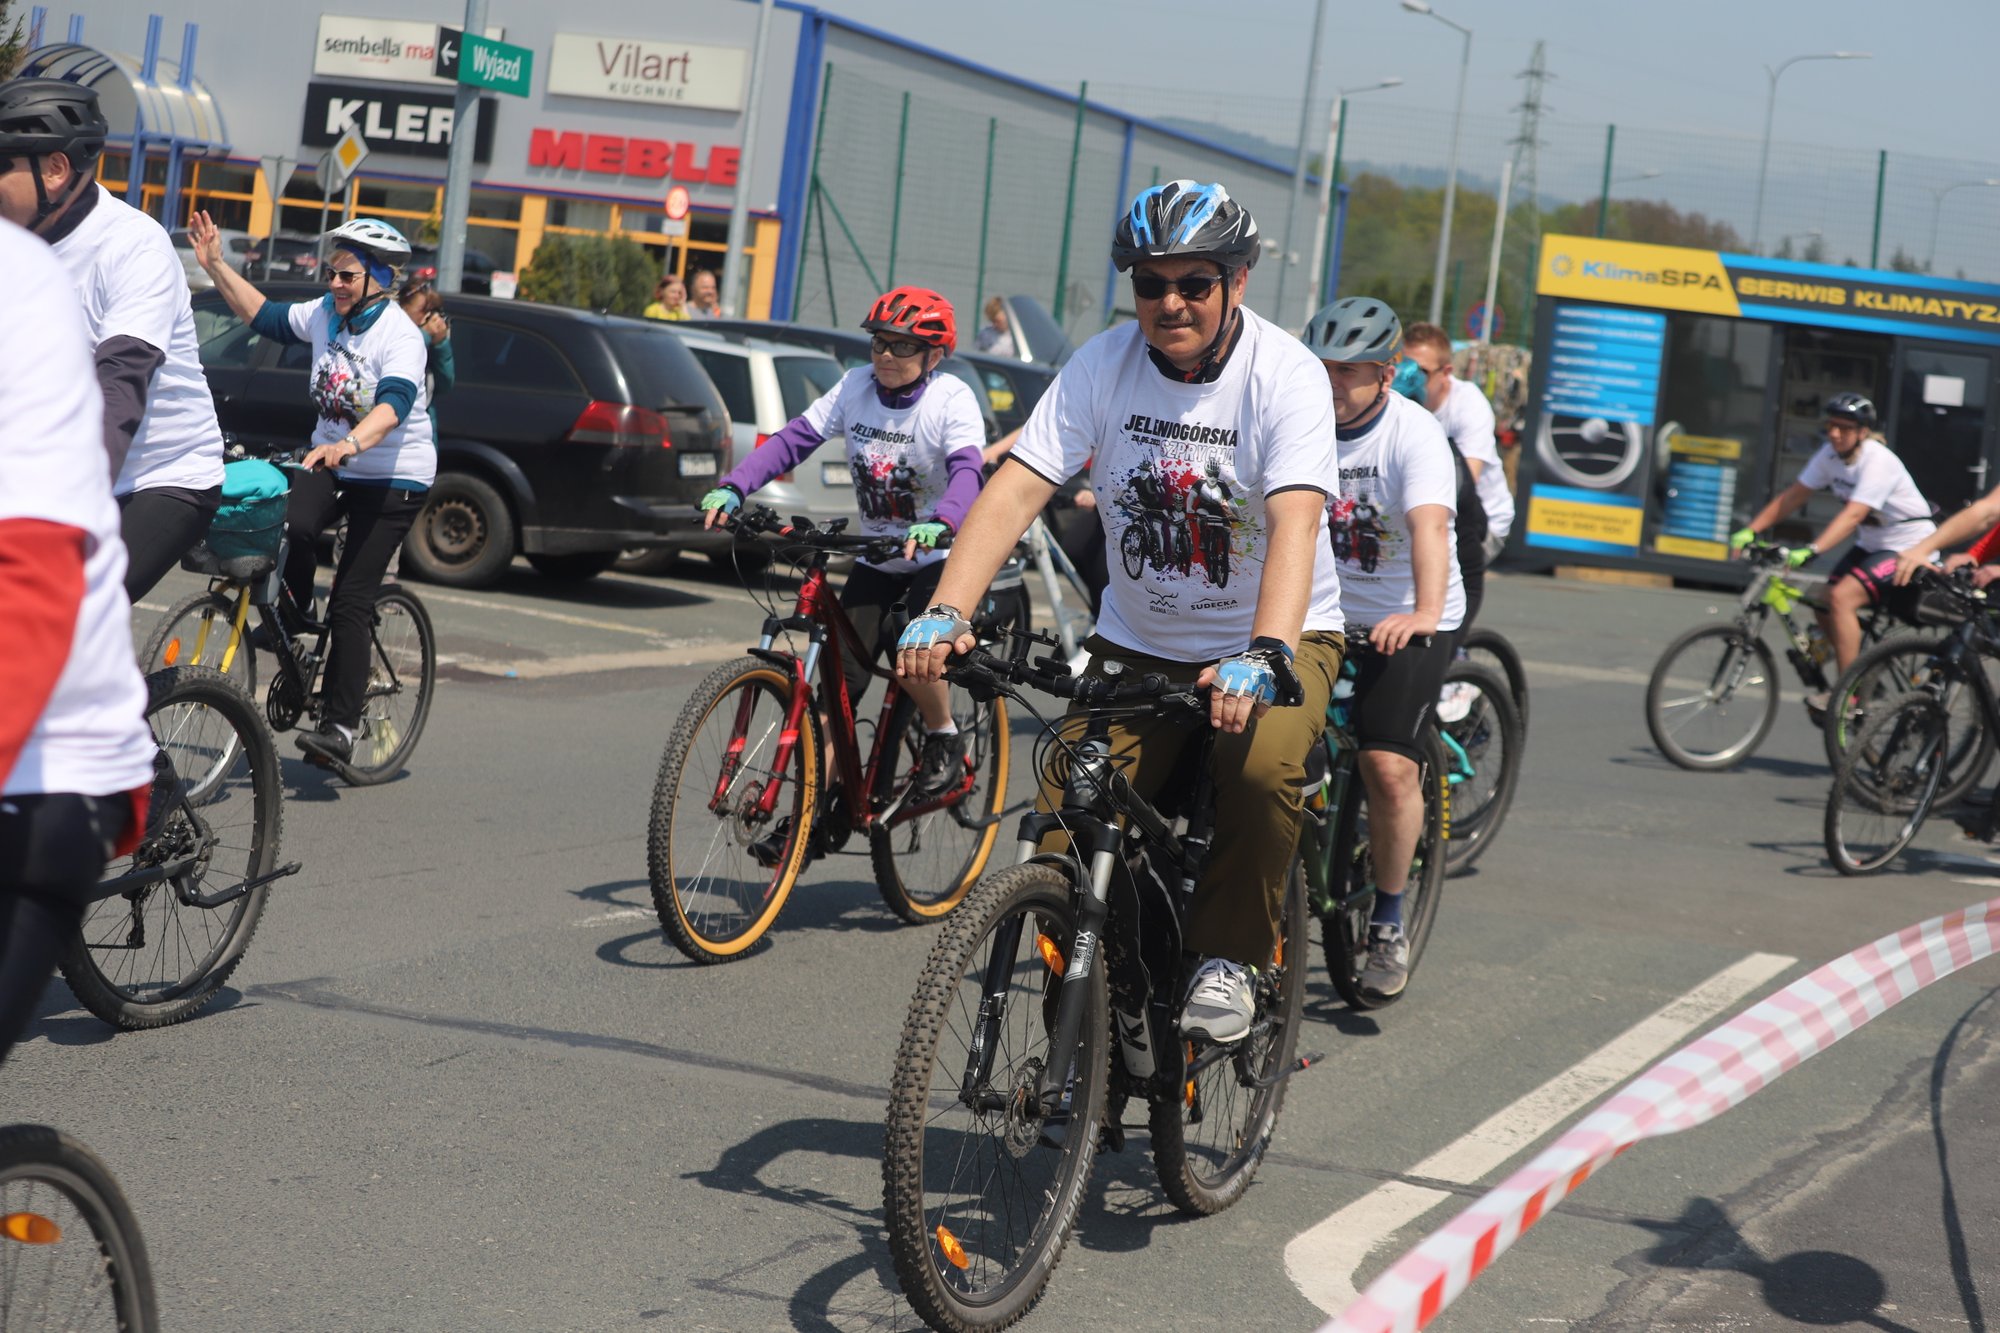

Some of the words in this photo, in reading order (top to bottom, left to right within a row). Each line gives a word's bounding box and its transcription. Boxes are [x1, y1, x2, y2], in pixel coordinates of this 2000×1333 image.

[324, 35, 403, 57] sembella
[473, 44, 521, 82] Wyjazd
[597, 41, 691, 84] Vilart
[608, 82, 684, 100] KUCHNIE
[326, 98, 455, 144] KLER
[529, 128, 741, 186] MEBLE
[1582, 261, 1723, 292] KlimaSPA
[1737, 277, 1847, 305] SERWIS
[1160, 440, 1236, 467] SZPRYCHA
[1190, 600, 1238, 611] SUDECKA
[1042, 1121, 1098, 1269] SCHWALBE
